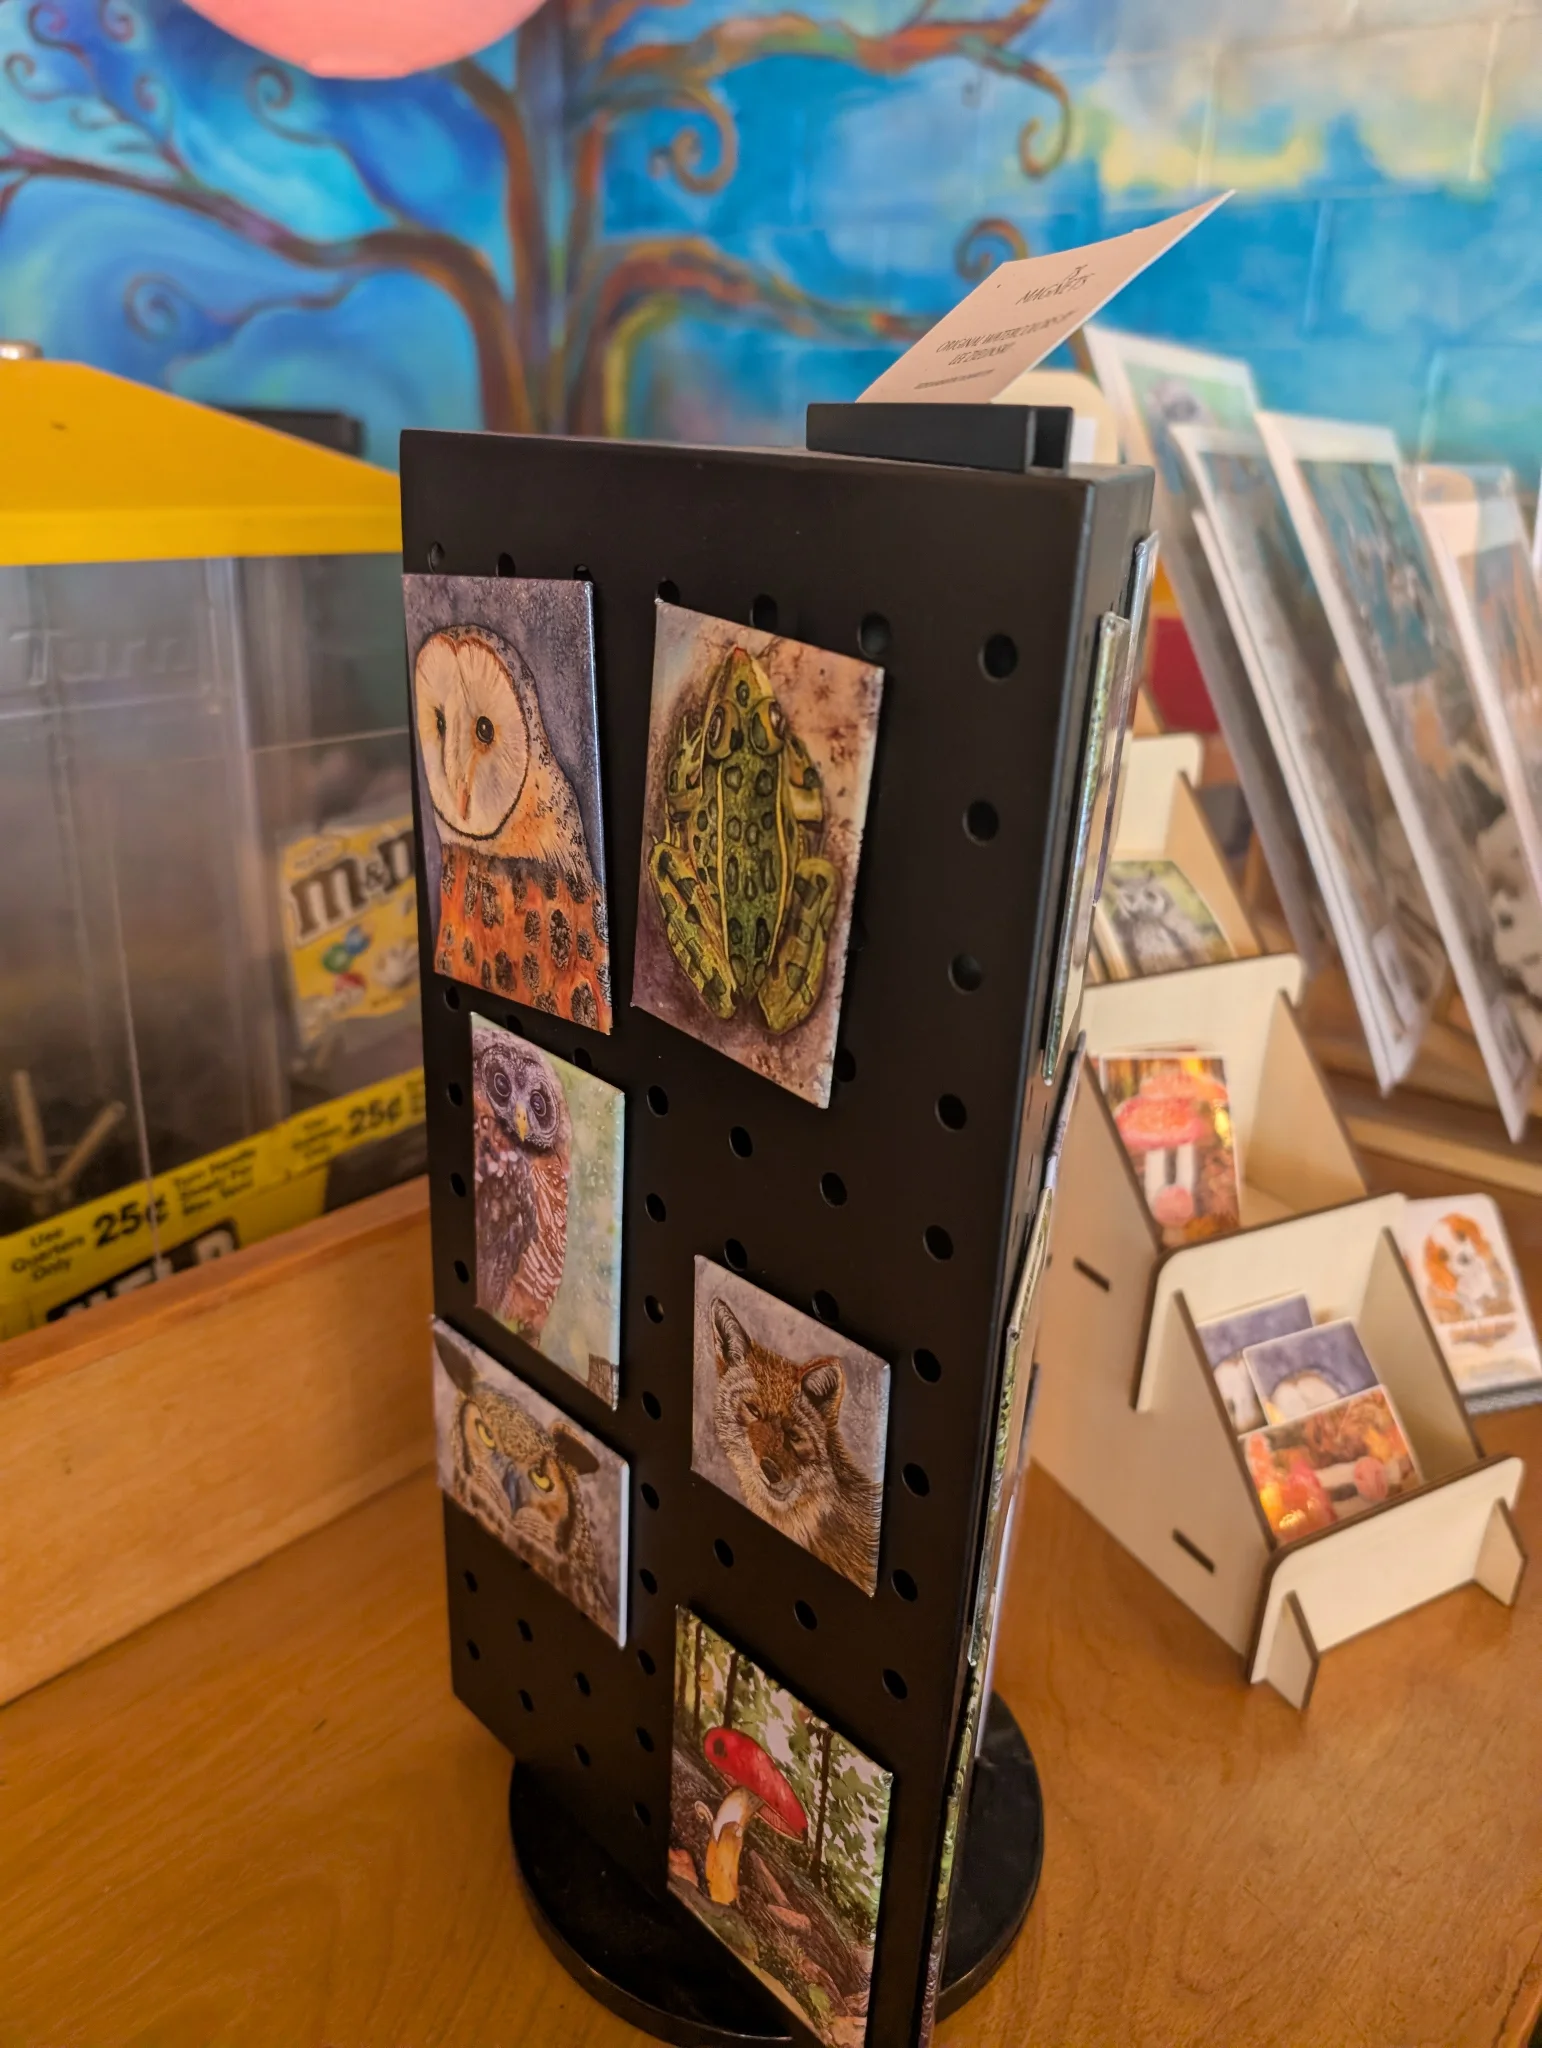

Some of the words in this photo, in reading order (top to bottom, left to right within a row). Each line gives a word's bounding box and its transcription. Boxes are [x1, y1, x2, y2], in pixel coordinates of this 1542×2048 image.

[1015, 273, 1096, 305] MAGNETS
[936, 335, 986, 353] ORIGINAL
[93, 1194, 169, 1248] 25¢
[30, 1228, 65, 1248] Use
[11, 1235, 85, 1273] Quarters
[32, 1257, 72, 1282] Only
